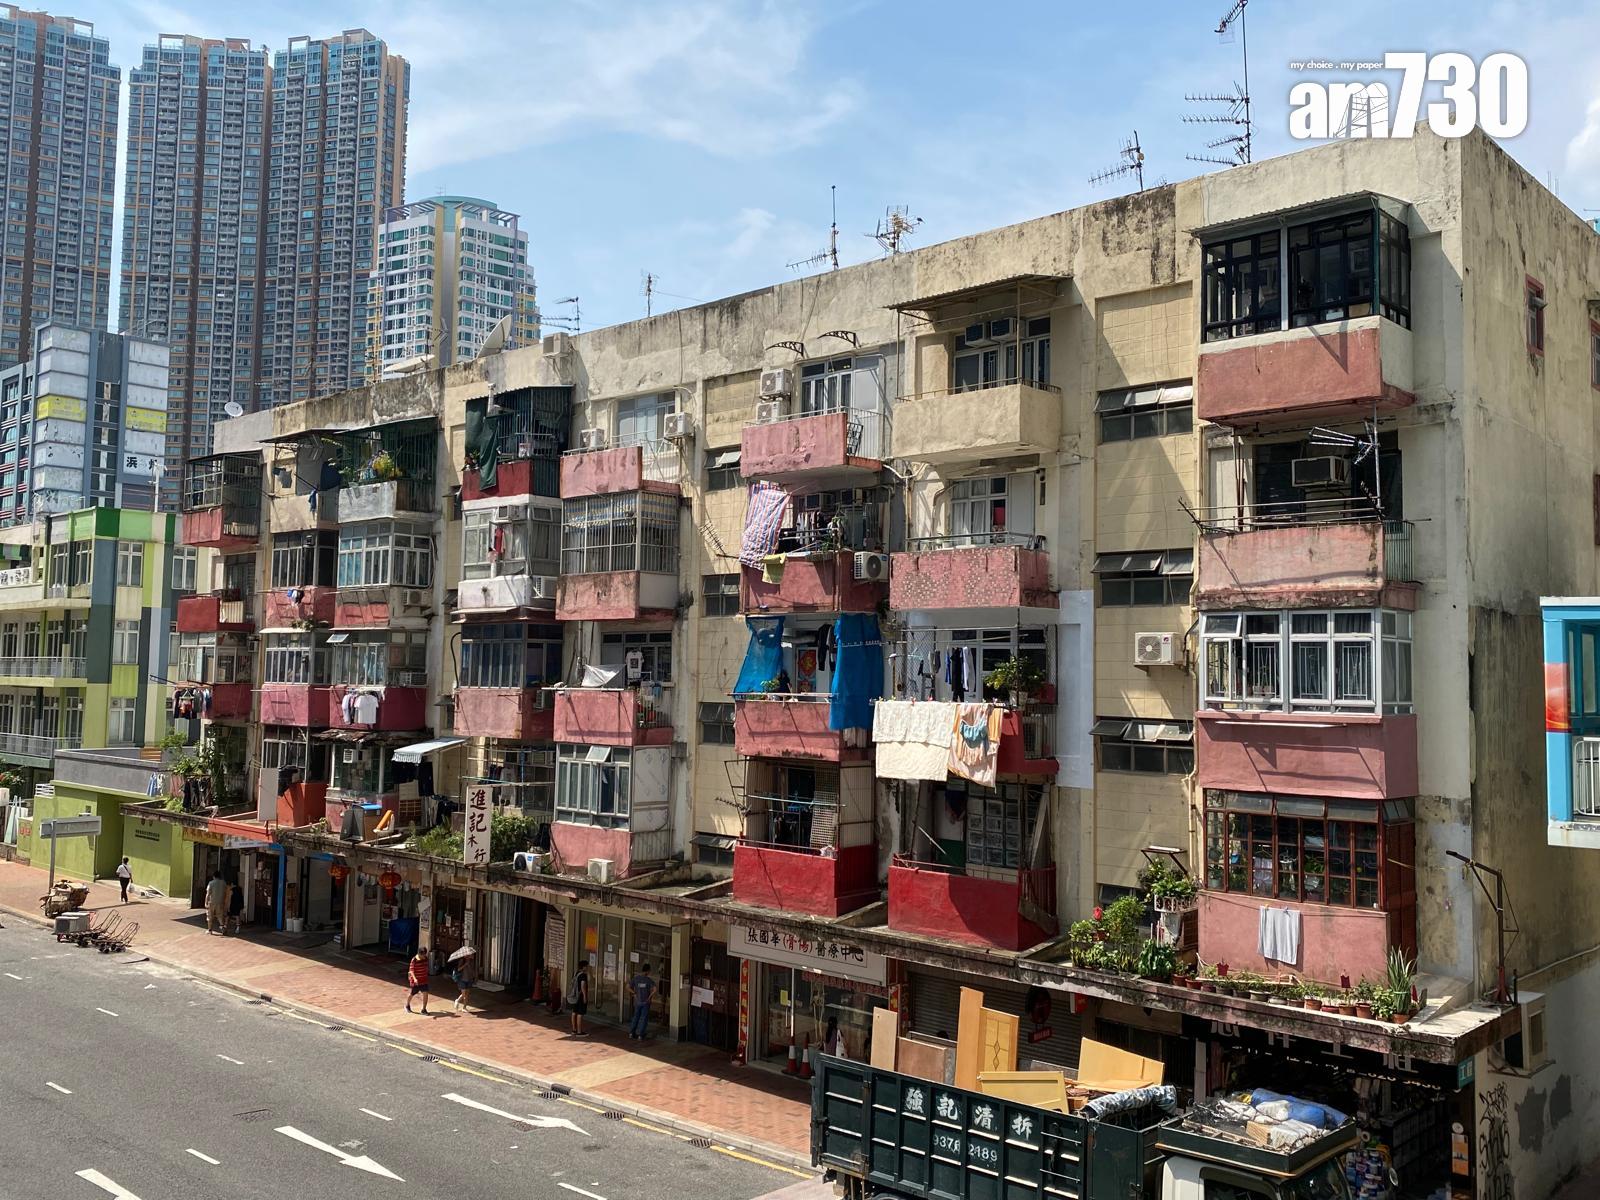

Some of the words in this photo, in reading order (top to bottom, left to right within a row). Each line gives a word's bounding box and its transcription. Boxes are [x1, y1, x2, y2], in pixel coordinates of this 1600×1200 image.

[467, 789, 488, 862] 進記木行
[906, 1087, 1034, 1140] 強記清拆
